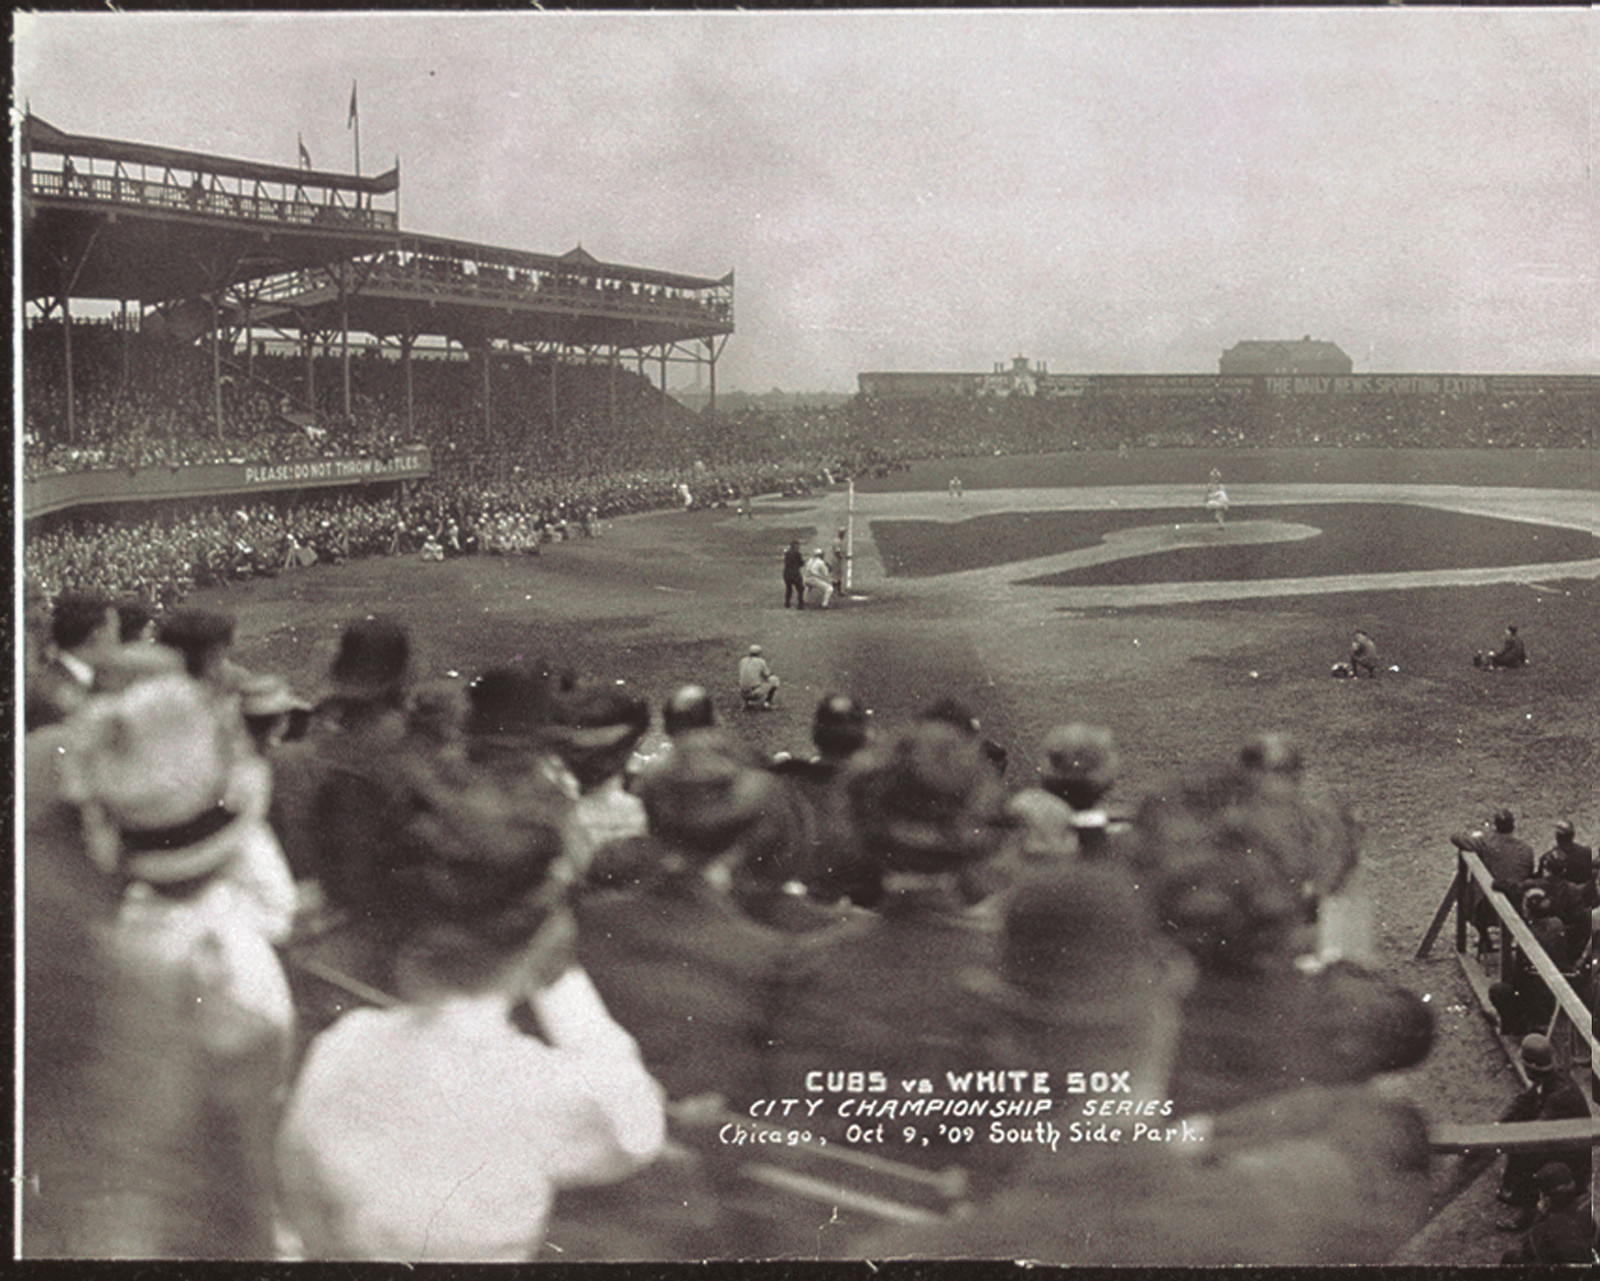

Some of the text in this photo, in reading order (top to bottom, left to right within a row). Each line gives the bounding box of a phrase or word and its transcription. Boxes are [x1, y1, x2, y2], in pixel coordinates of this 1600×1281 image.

[1264, 377, 1292, 394] THE
[1294, 377, 1331, 394] DAILY
[1334, 377, 1374, 394] NEWS
[1443, 377, 1487, 394] EXTRA
[295, 464, 308, 479] DO
[310, 461, 332, 477] NOT
[335, 459, 372, 475] THROW
